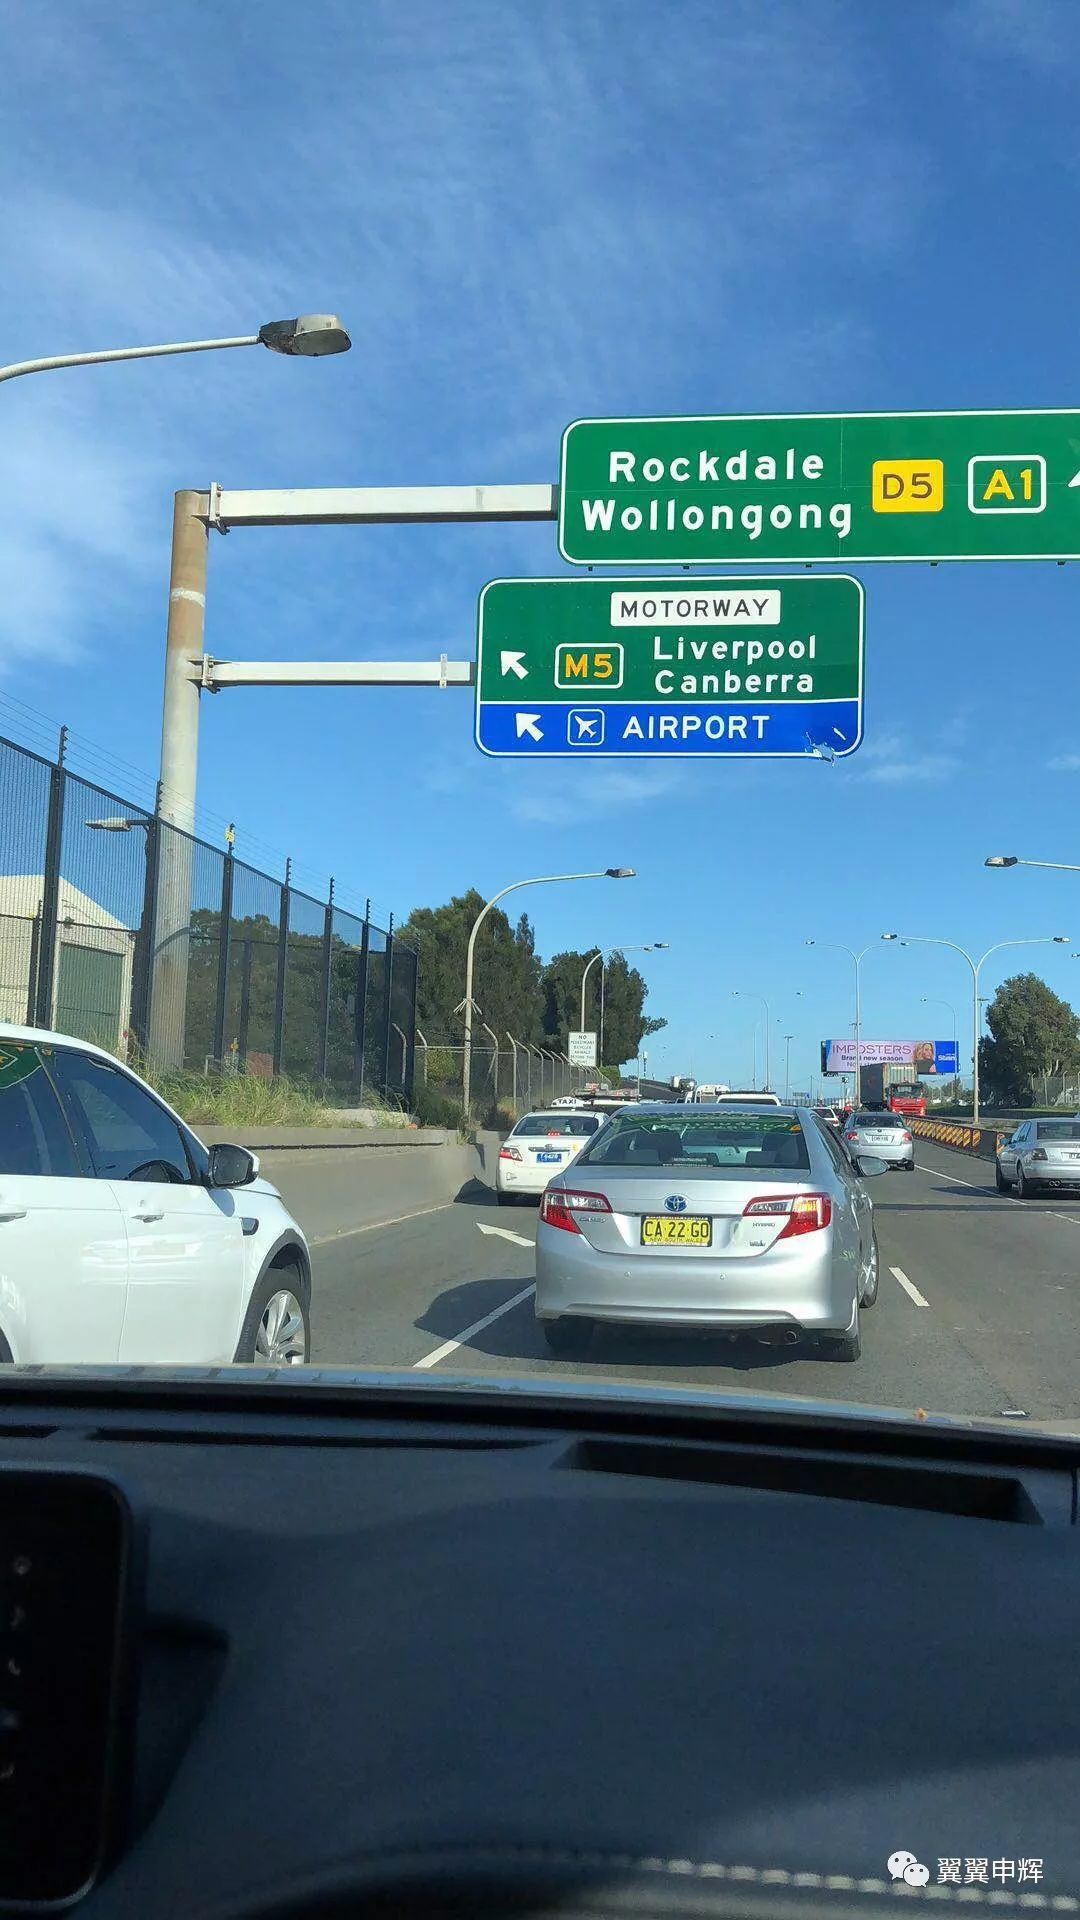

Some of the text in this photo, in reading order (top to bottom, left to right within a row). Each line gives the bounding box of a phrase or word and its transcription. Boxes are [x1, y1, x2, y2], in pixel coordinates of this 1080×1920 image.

[610, 448, 824, 483] Rockdale
[882, 473, 933, 500] D5
[983, 470, 1032, 500] A1
[583, 499, 852, 540] Wollongong
[620, 599, 770, 618] MOTORWAY
[654, 635, 817, 665] Liverpool
[566, 654, 613, 678] M5
[655, 669, 813, 695] Canberra
[623, 716, 770, 739] AIRPORT
[832, 1045, 911, 1055] IMPOSTERS
